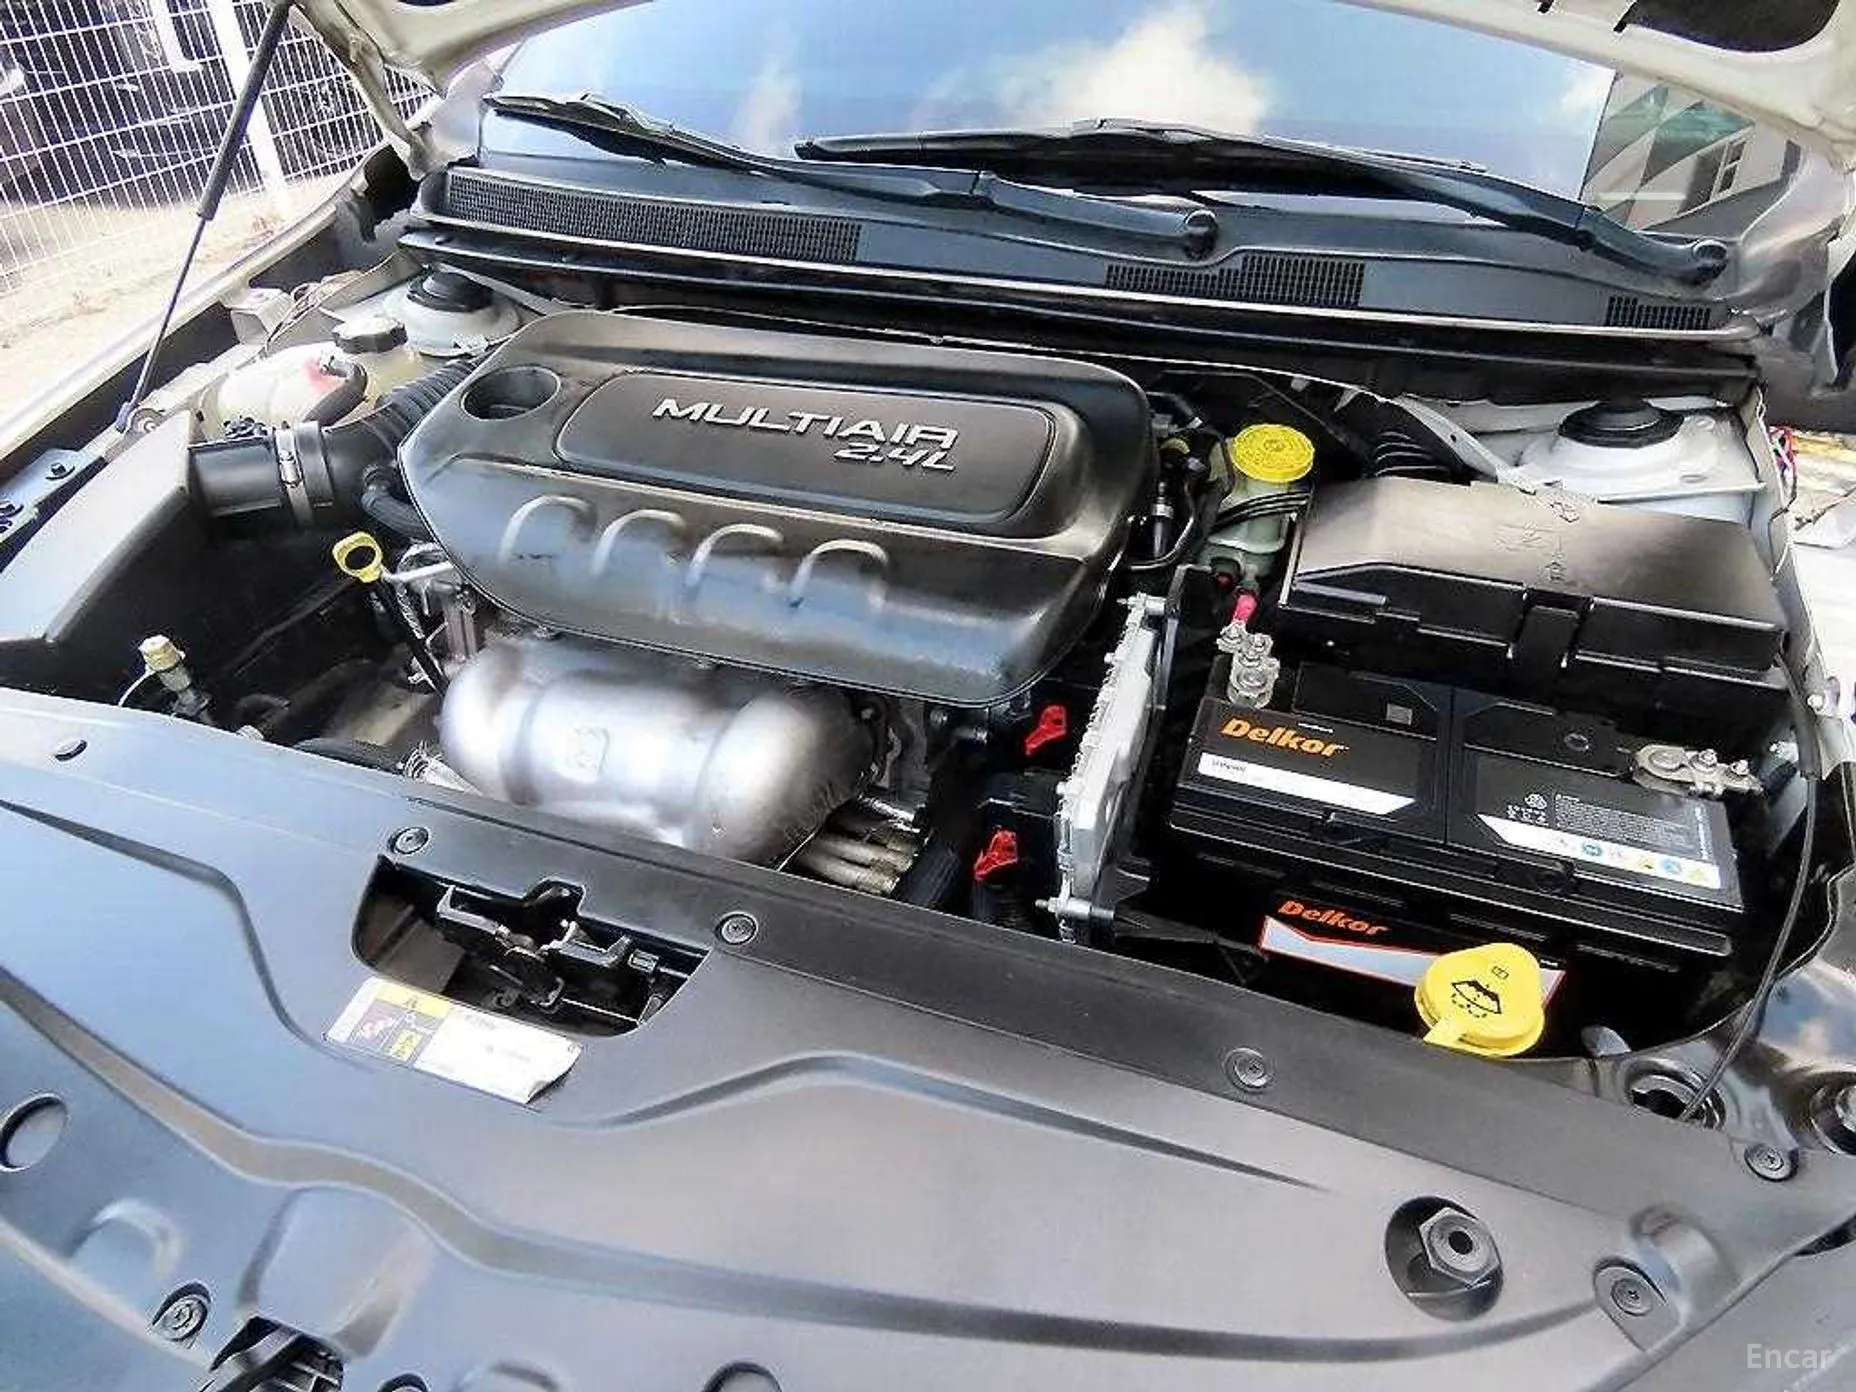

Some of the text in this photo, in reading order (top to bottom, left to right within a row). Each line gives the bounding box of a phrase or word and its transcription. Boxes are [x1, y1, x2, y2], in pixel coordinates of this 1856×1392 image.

[652, 398, 958, 449] MULTIAIR
[834, 442, 955, 471] 2.4L
[1221, 717, 1349, 757] Delkor
[1278, 900, 1389, 935] Delkor
